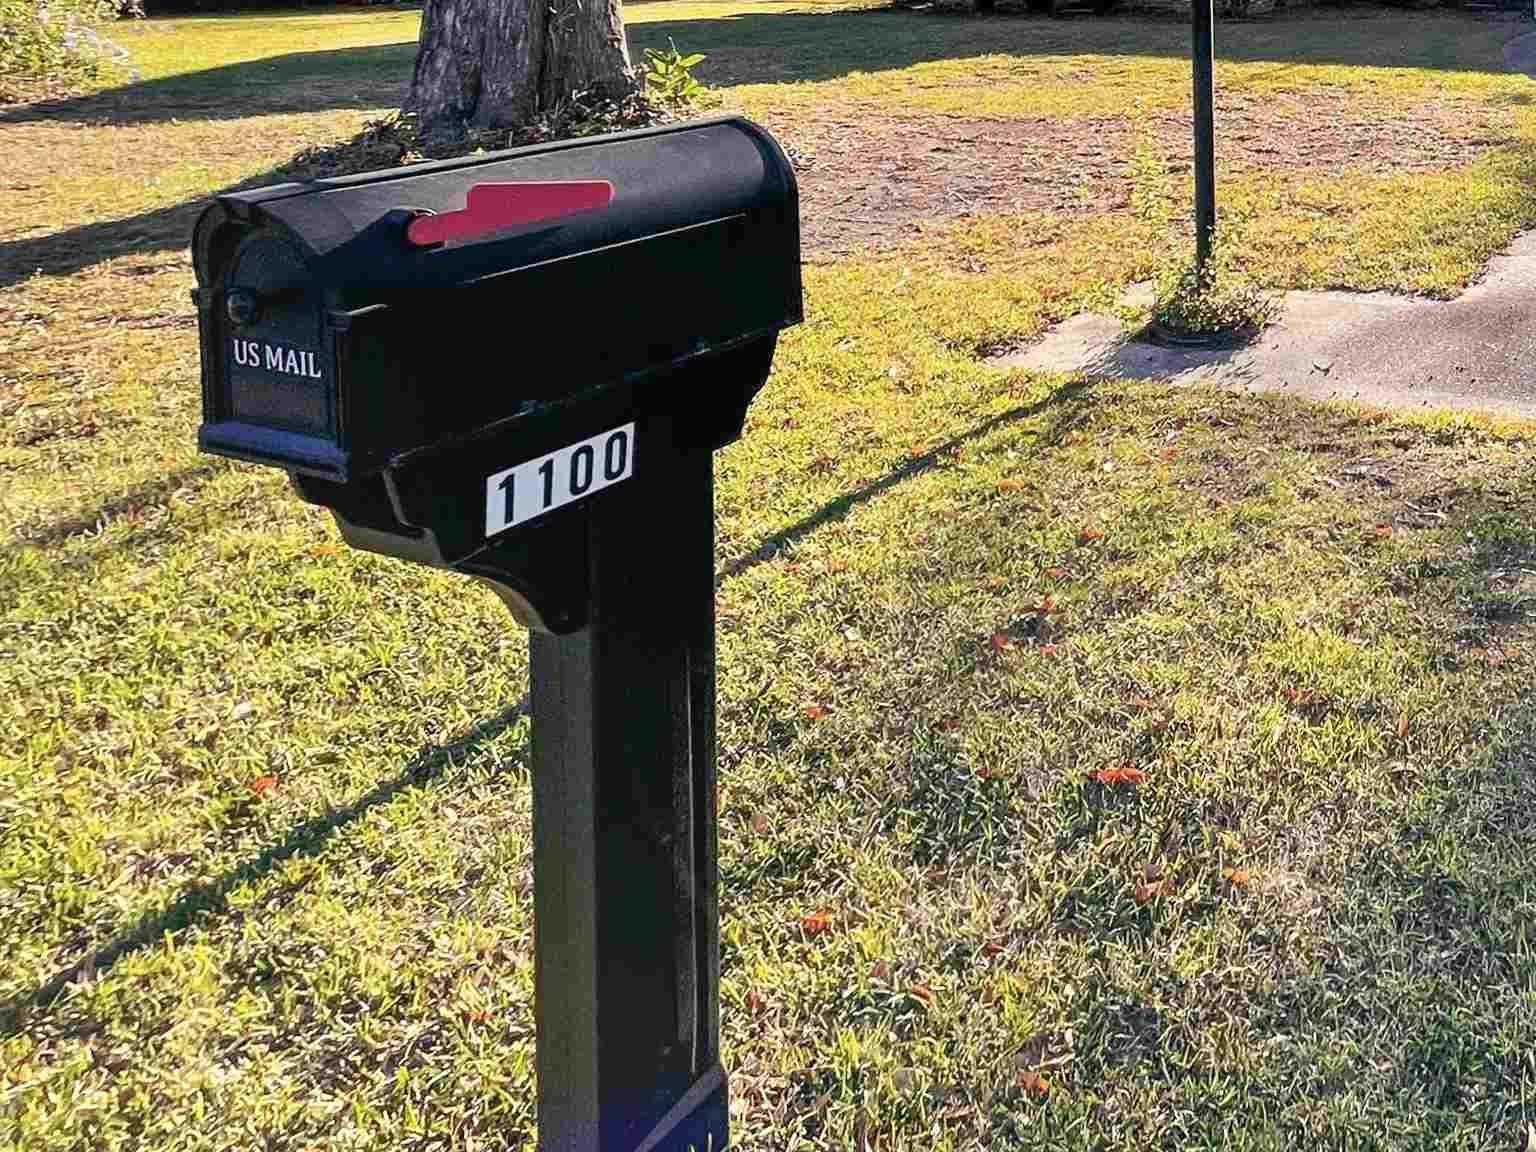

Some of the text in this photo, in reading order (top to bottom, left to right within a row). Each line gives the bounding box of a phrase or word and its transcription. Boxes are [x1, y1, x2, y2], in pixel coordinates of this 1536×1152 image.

[233, 339, 322, 378] US MAIL
[497, 429, 628, 525] 1100
